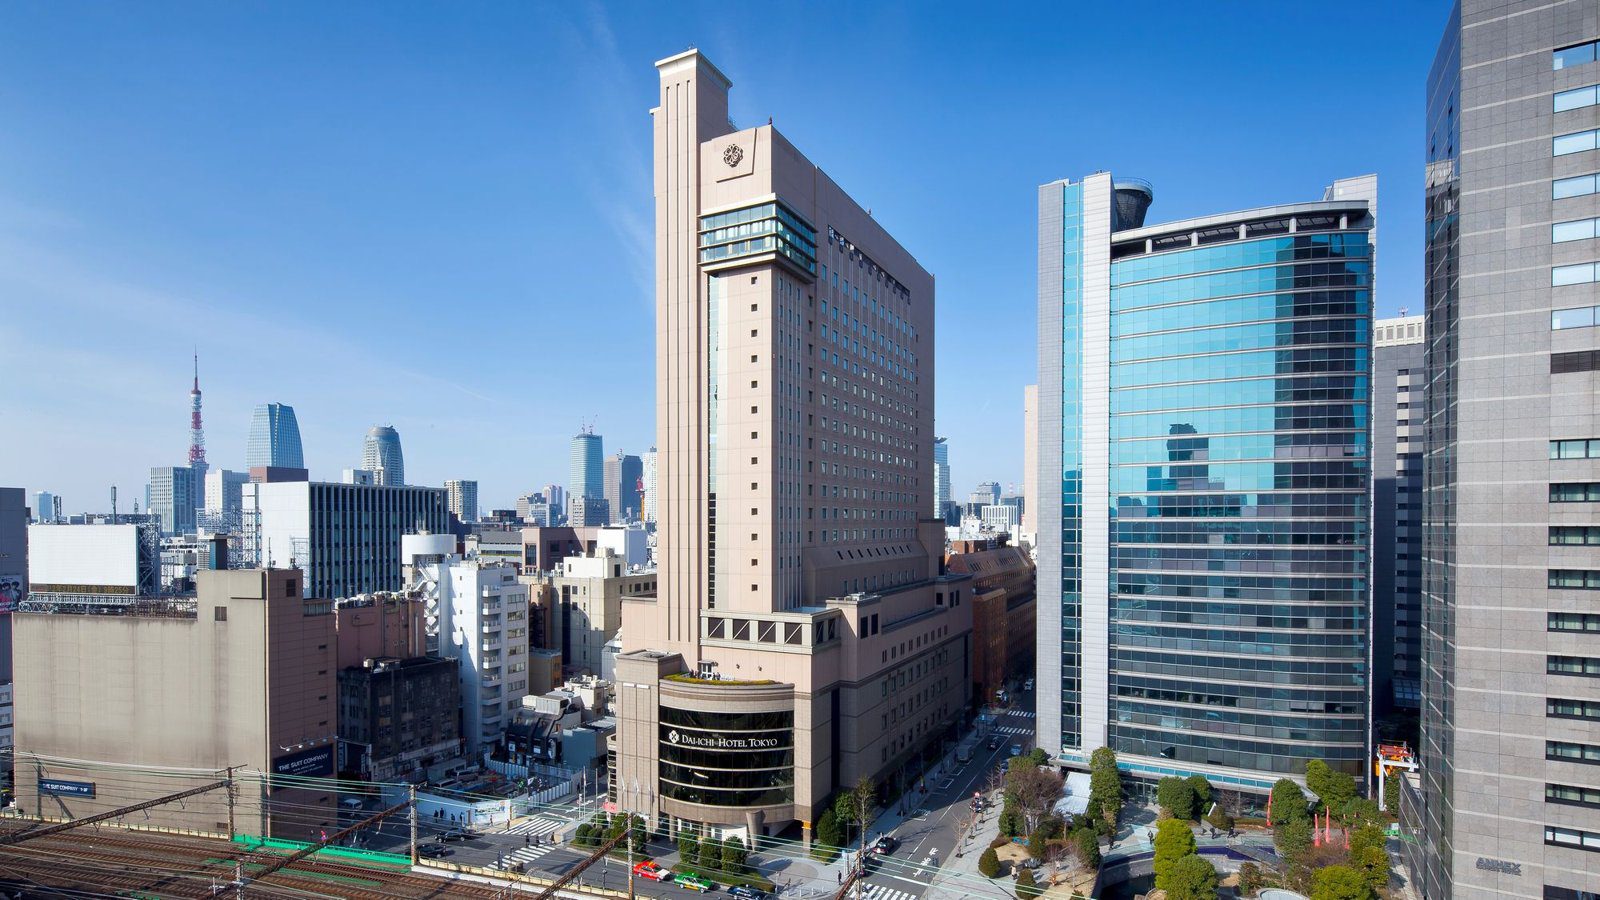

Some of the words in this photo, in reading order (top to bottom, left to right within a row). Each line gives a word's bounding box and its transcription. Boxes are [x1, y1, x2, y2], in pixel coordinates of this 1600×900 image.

[682, 734, 715, 747] DAI-ICHI
[718, 738, 747, 748] HOTEL
[748, 738, 777, 748] TOKYO
[291, 759, 303, 768] SUIT
[303, 753, 328, 765] COMPANY
